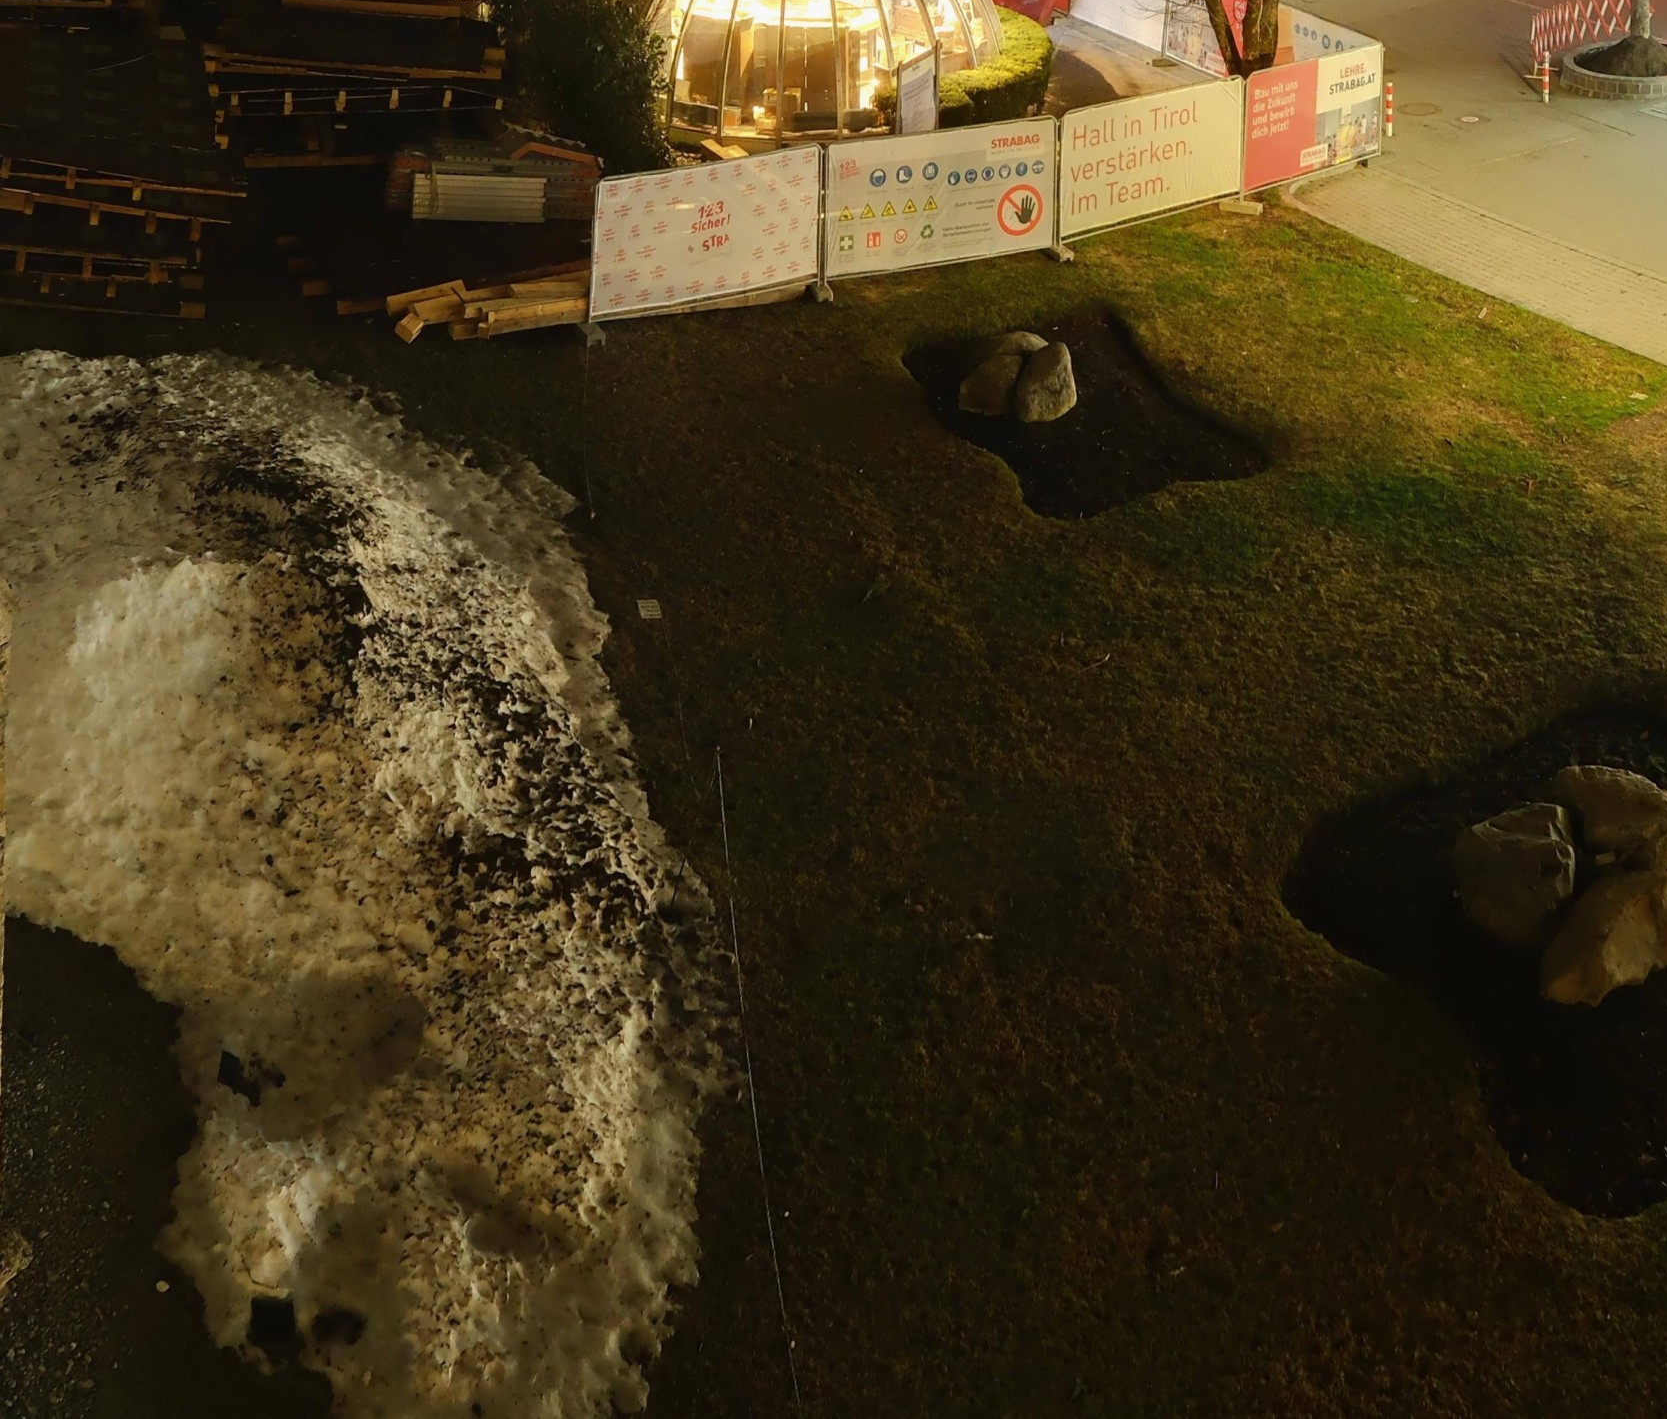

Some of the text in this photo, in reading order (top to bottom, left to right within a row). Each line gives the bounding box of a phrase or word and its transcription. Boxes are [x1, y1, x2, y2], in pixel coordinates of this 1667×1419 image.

[1254, 81, 1298, 100] Bau mit uns
[1329, 73, 1376, 95] STRABAG.AT
[1253, 93, 1296, 113] die Zukunft
[1073, 100, 1198, 150] Hall in Tirol
[1252, 113, 1267, 126] und
[991, 134, 1040, 149] STRABAG
[1252, 126, 1268, 139] dich
[1071, 140, 1193, 182] verstärken.
[1071, 176, 1170, 216] Im Team.
[691, 214, 731, 234] Sicher!
